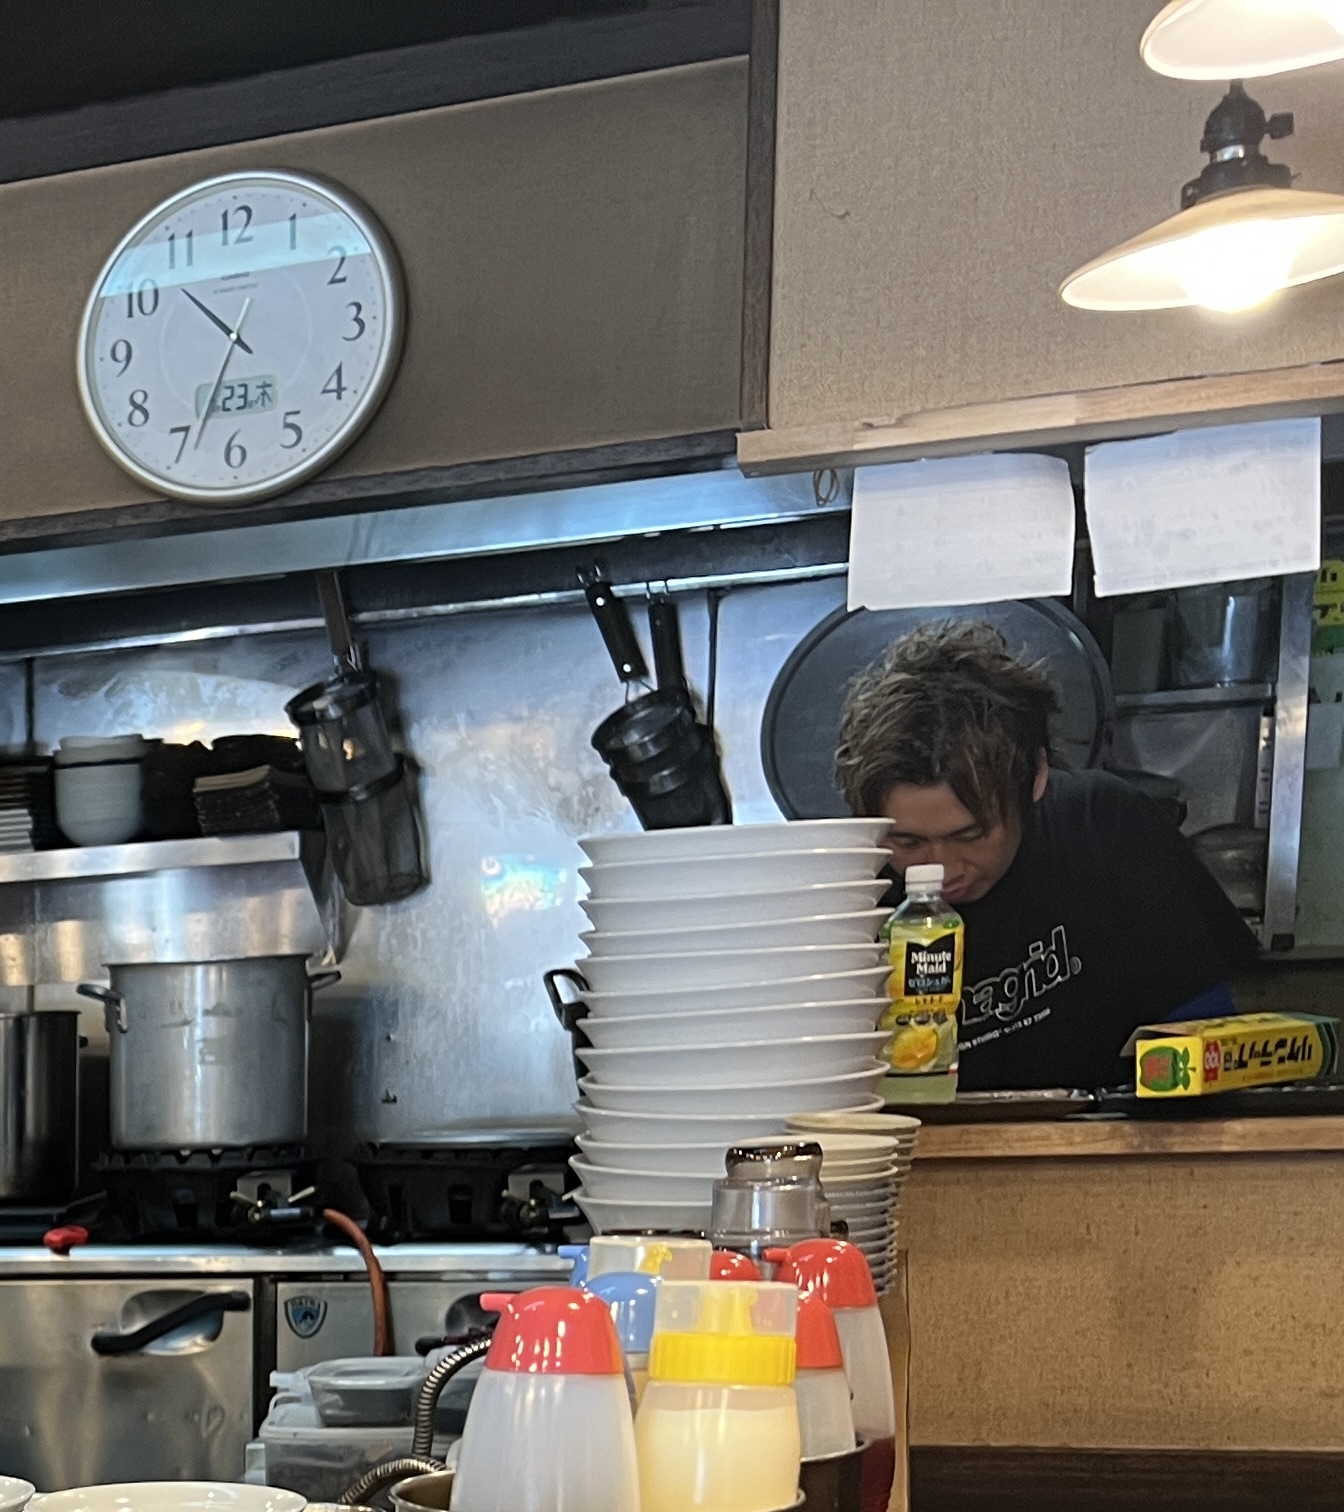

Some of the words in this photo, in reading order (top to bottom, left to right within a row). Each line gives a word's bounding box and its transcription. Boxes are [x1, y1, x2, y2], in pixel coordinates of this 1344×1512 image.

[221, 205, 253, 247] 12
[288, 213, 298, 250] 1
[168, 230, 195, 270] 11
[326, 246, 348, 285] 2
[126, 279, 159, 318] 10
[342, 302, 366, 341] 3
[110, 339, 133, 377] 9
[321, 361, 348, 401] 4
[128, 389, 150, 427] 8
[169, 425, 190, 464] 7
[223, 430, 247, 469] 6
[279, 411, 303, 449] 5
[911, 951, 952, 964] Minute
[916, 961, 947, 975] Maid
